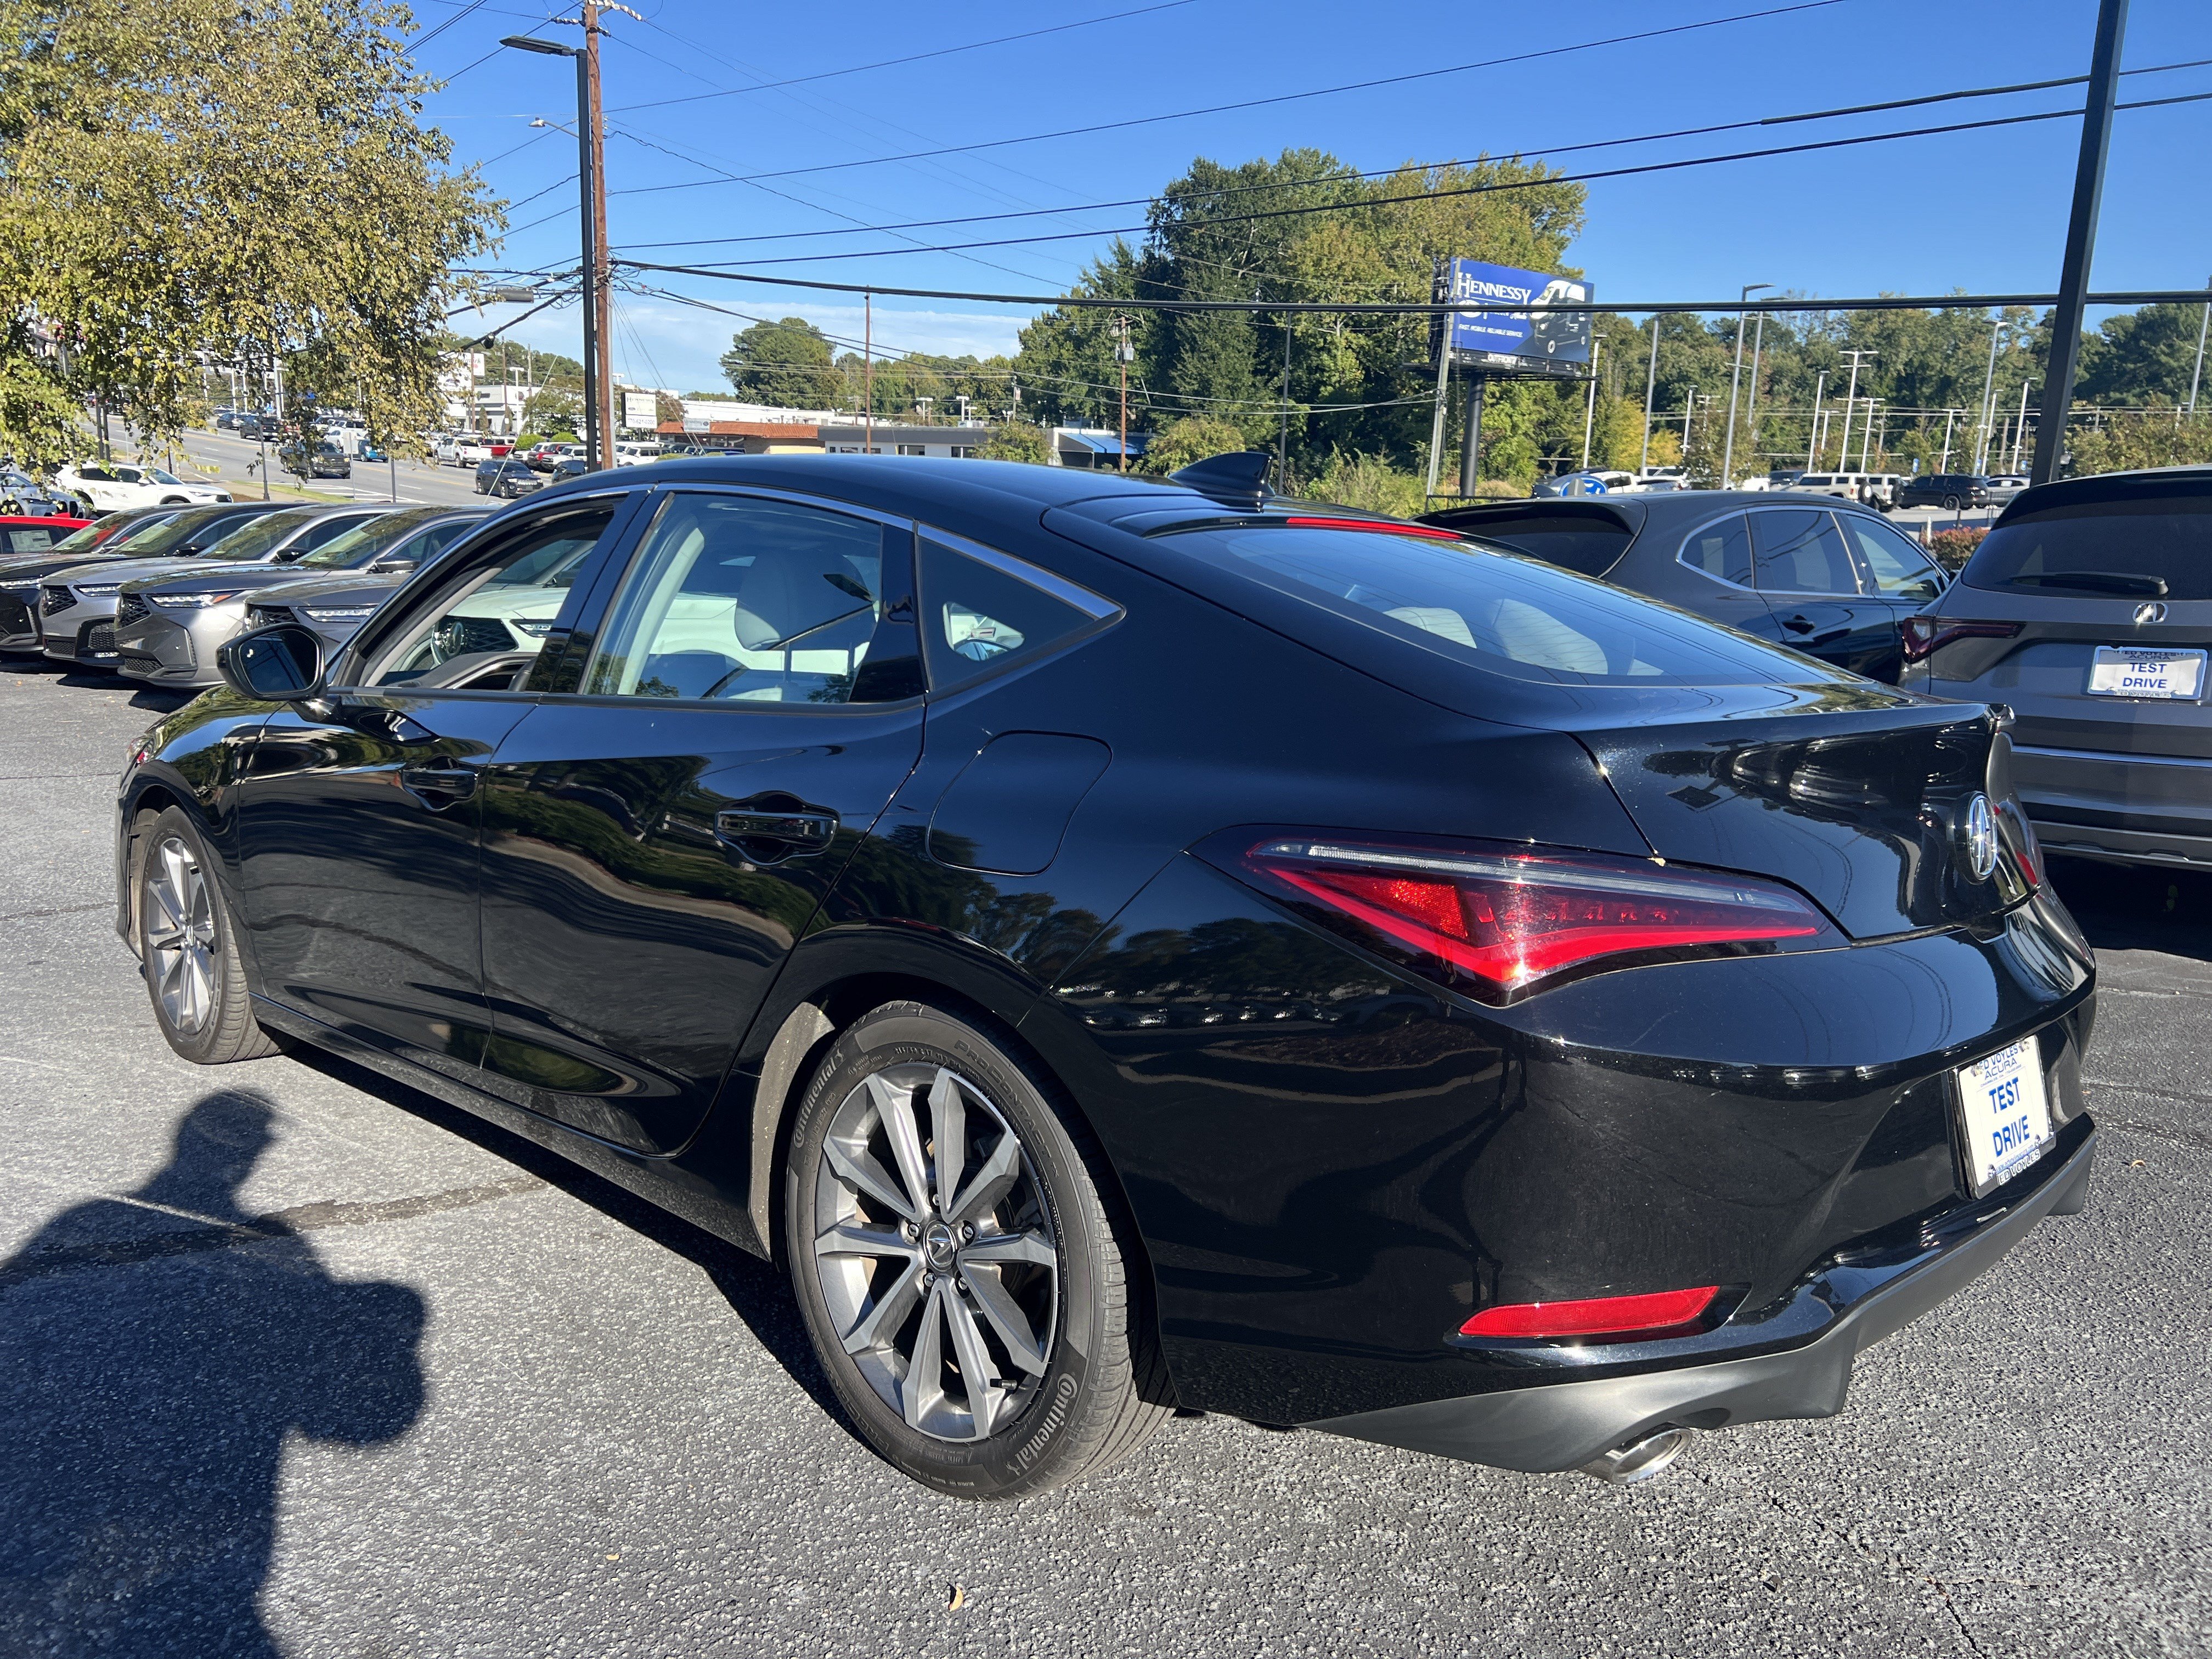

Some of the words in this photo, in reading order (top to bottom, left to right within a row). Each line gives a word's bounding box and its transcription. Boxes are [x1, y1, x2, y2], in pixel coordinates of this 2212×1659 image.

[1457, 272, 1532, 305] HENNESSY
[2123, 678, 2168, 689] DRIVE
[2129, 662, 2167, 673] TEST
[1985, 1057, 2017, 1080] ACURA
[1991, 1044, 2018, 1065] VOYLES
[793, 1056, 837, 1148] Continental
[1989, 1076, 2021, 1114] TEST
[1992, 1114, 2030, 1158] DRIVE
[1999, 1169, 2011, 1185] ED
[2010, 1149, 2041, 1177] VOYLES
[1015, 1373, 1078, 1470] Continental
